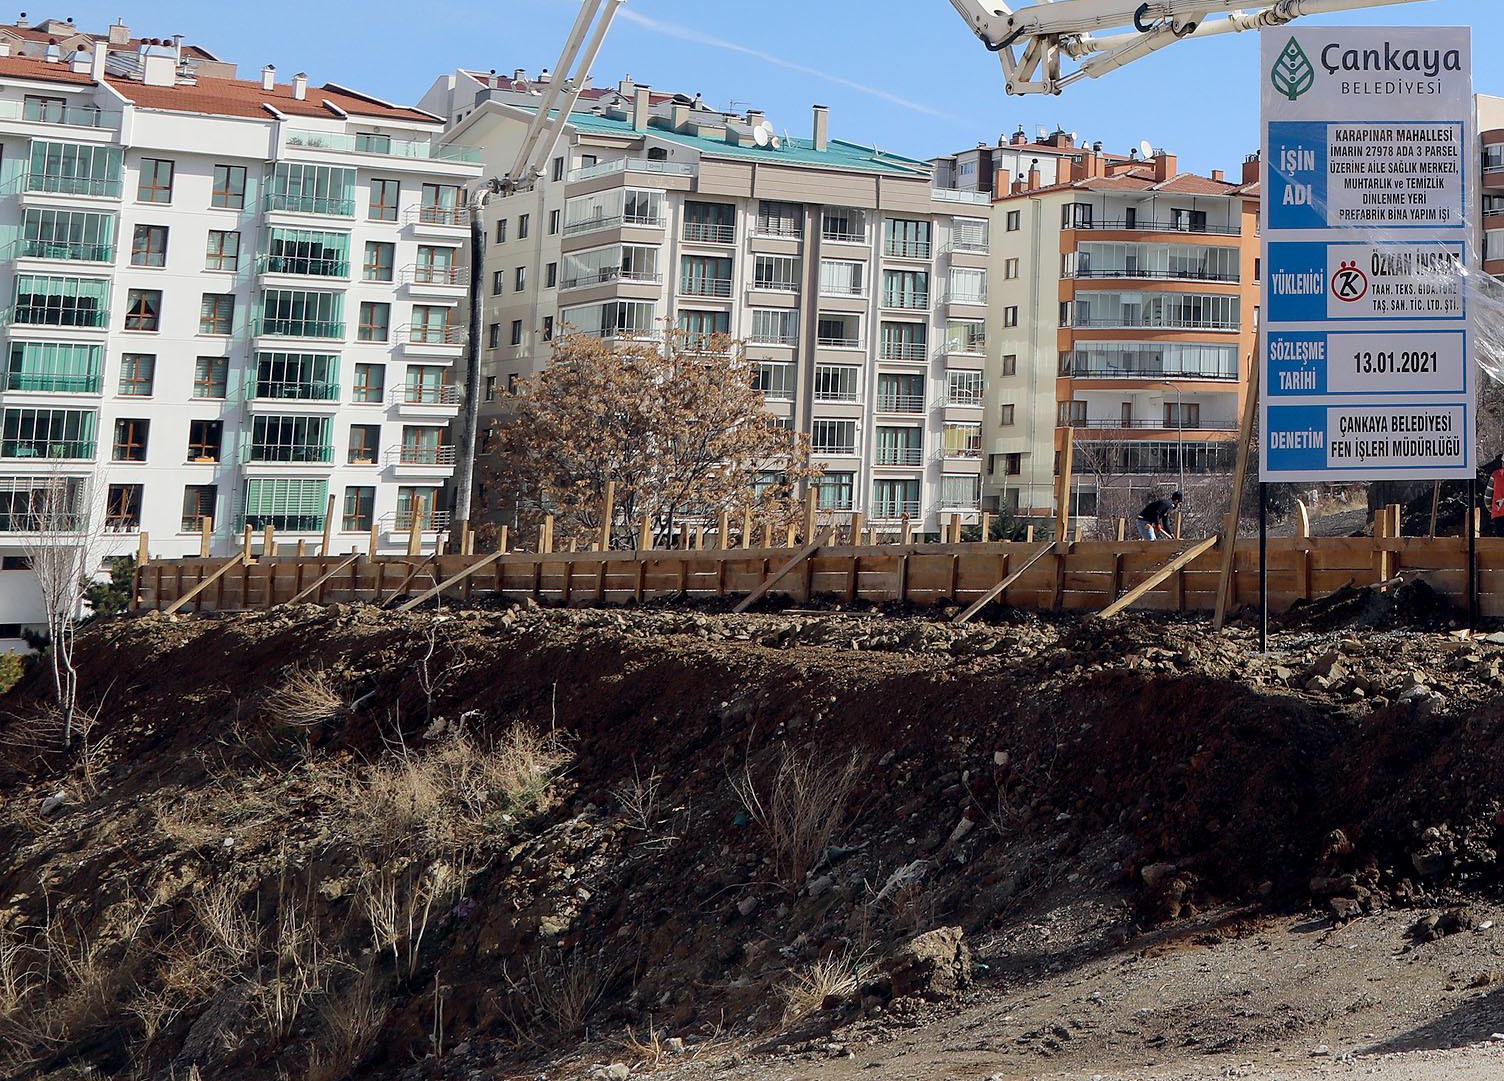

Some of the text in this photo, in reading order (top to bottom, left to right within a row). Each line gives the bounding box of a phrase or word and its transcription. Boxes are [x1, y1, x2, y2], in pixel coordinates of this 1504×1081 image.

[1321, 41, 1461, 77] Çankaya
[1341, 79, 1441, 94] BELEDİYESİ
[1335, 127, 1453, 142] KARAPINAR MAHALLESİ
[1281, 145, 1315, 176] İŞİN
[1330, 144, 1457, 156] İMARIN 27978 ADA 3 PARSEL
[1330, 160, 1459, 176] ÜZERİNE AİLE SAĞLIK MERKEZİ,
[1344, 175, 1444, 189] MUHTARLIK ve TEMİZLİK
[1283, 185, 1311, 206] ADI
[1362, 191, 1426, 205] DİNLENME YERİ
[1340, 206, 1450, 222] PREFABRİK BİNA YAPIM İŞİ
[1371, 249, 1412, 277] ÖZKAN
[1272, 268, 1324, 295] YÜKLENİCİ
[1372, 284, 1393, 295] TAAH.
[1395, 284, 1415, 294] TEKS.
[1373, 297, 1458, 313] TAŞ. SAN. TİC. LTD. ŞTİ.
[1270, 338, 1324, 365] SÖZLEŞME
[1354, 351, 1437, 373] 13.01.2021
[1279, 367, 1316, 390] TARİHİ
[1340, 411, 1451, 438] ÇANKAYA BELEDİYESİ
[1271, 427, 1324, 449] DENETİM
[1331, 436, 1460, 461] FEN İŞLERİ MÜDÜRLÜĞÜ
